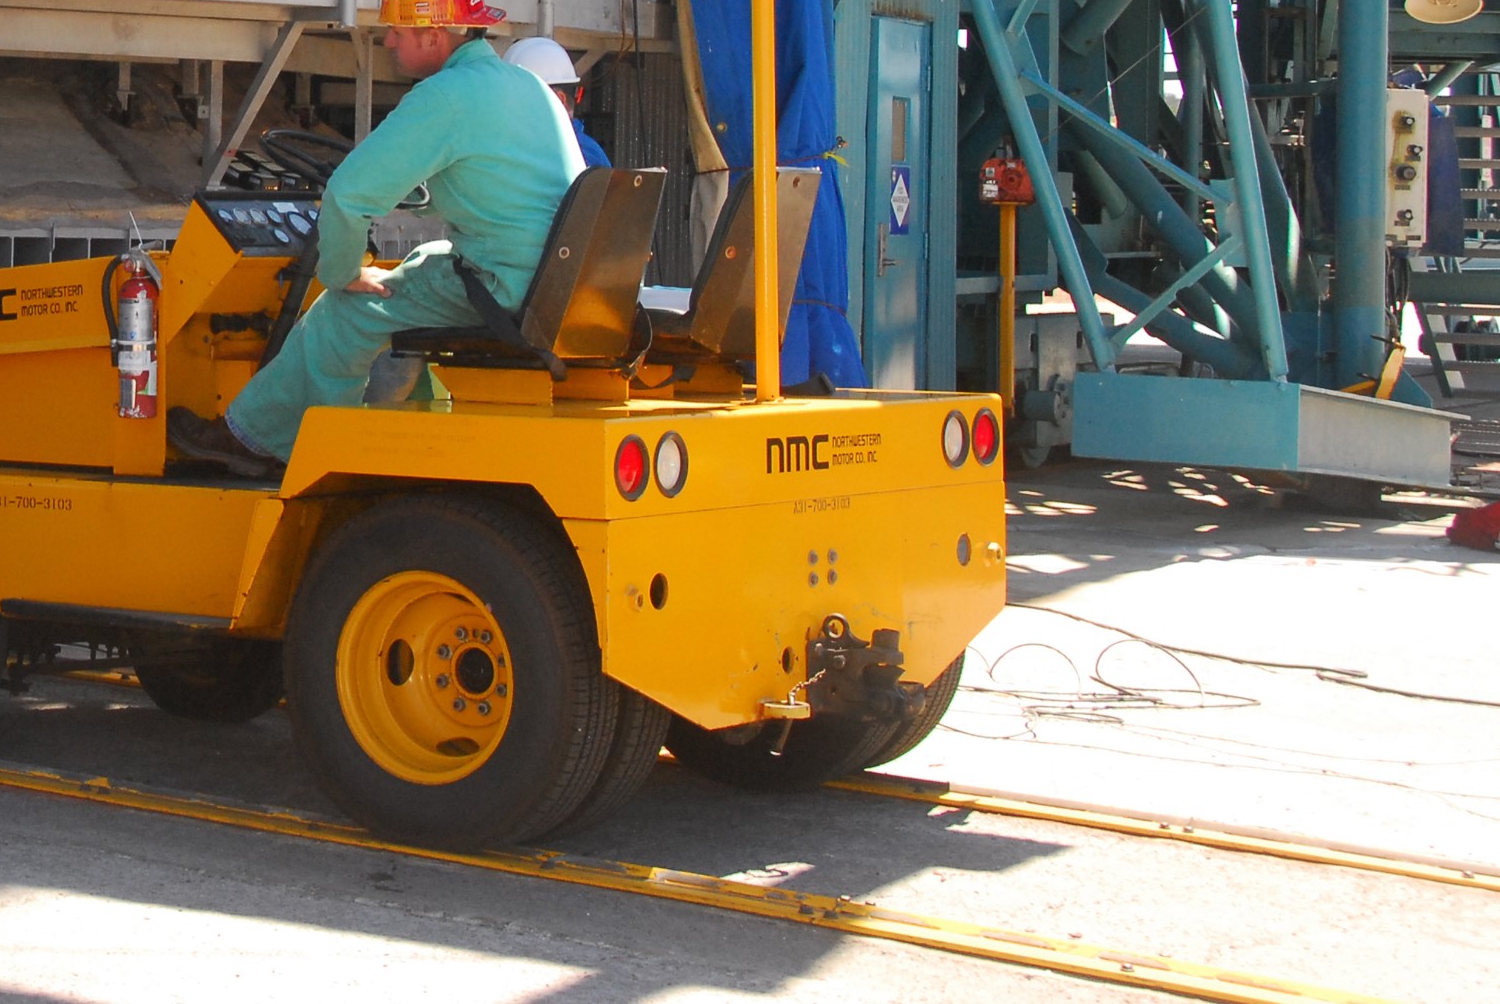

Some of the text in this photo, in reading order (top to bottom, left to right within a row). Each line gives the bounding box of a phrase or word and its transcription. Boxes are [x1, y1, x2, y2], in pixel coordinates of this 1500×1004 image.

[21, 284, 84, 300] NORTHWESTERN
[21, 303, 48, 317] MOTOR
[832, 433, 881, 448] NORTHWESTERN
[832, 452, 854, 466] MOTOR
[793, 497, 850, 515] A31-700-3103
